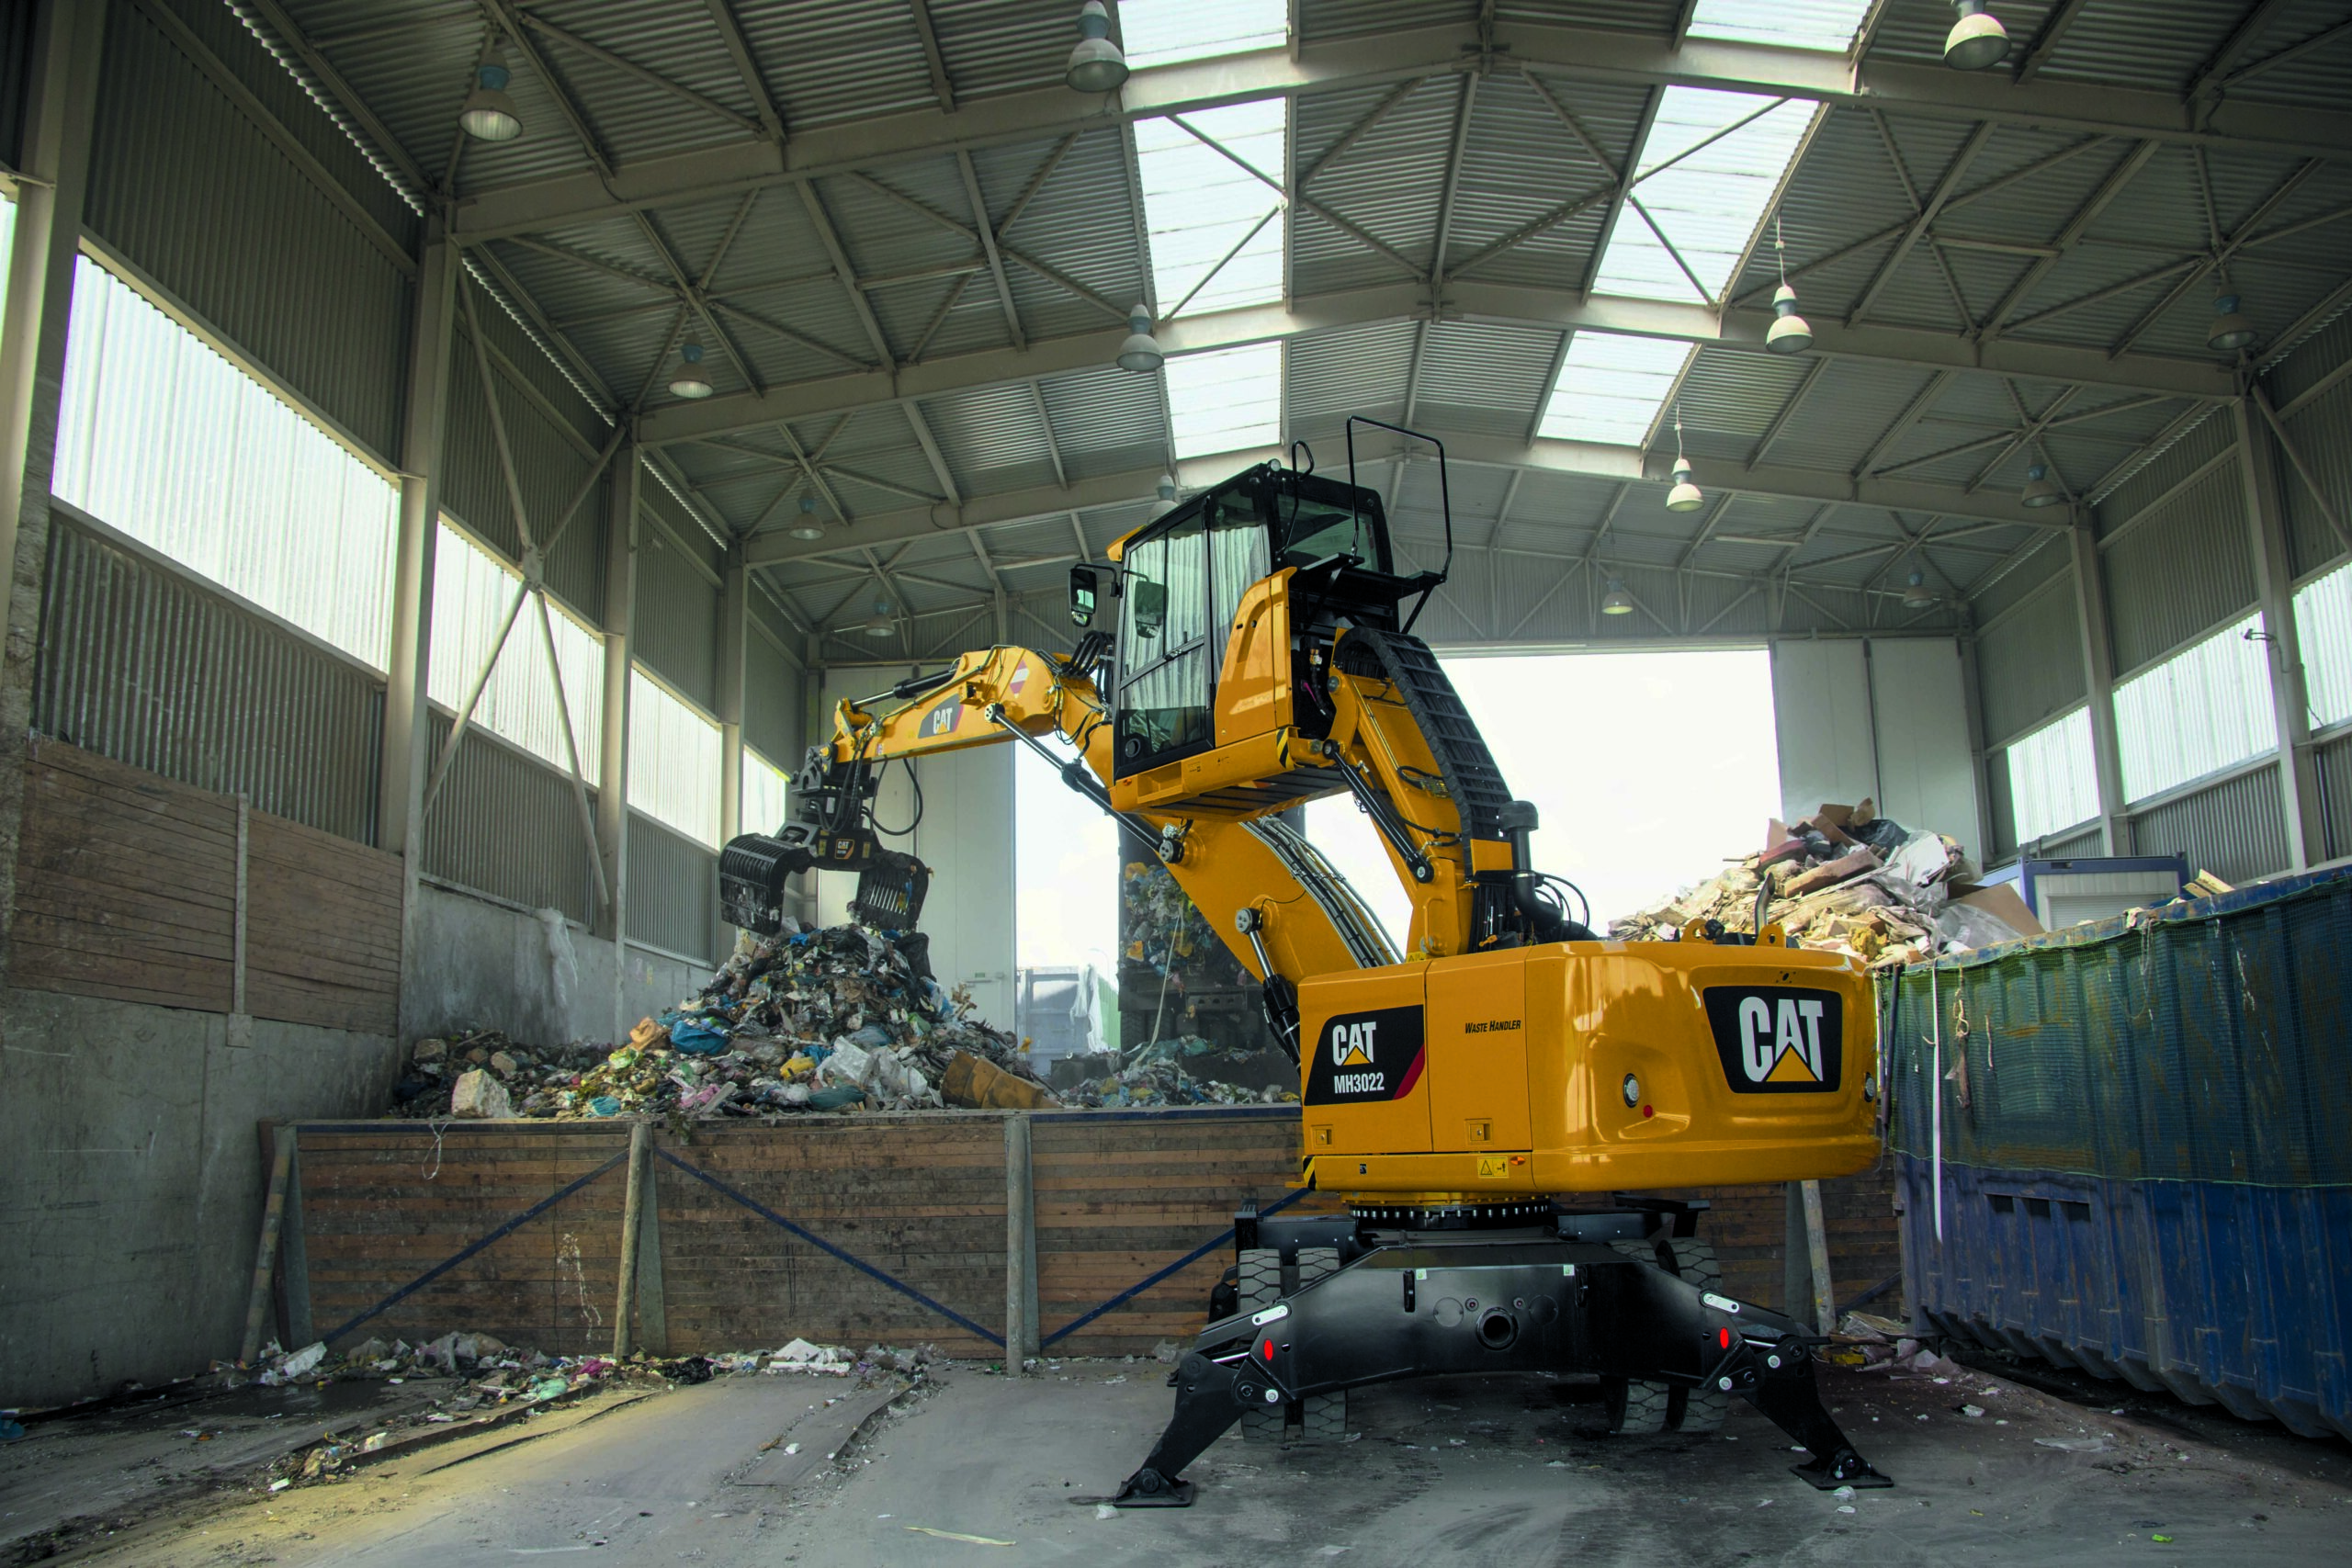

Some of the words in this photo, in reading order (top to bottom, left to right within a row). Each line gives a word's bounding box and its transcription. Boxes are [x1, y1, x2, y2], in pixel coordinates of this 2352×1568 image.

[933, 706, 953, 735] CAT
[1332, 1021, 1377, 1066] CAT
[1738, 996, 1825, 1083] CAT
[1333, 1072, 1385, 1094] MH3022
